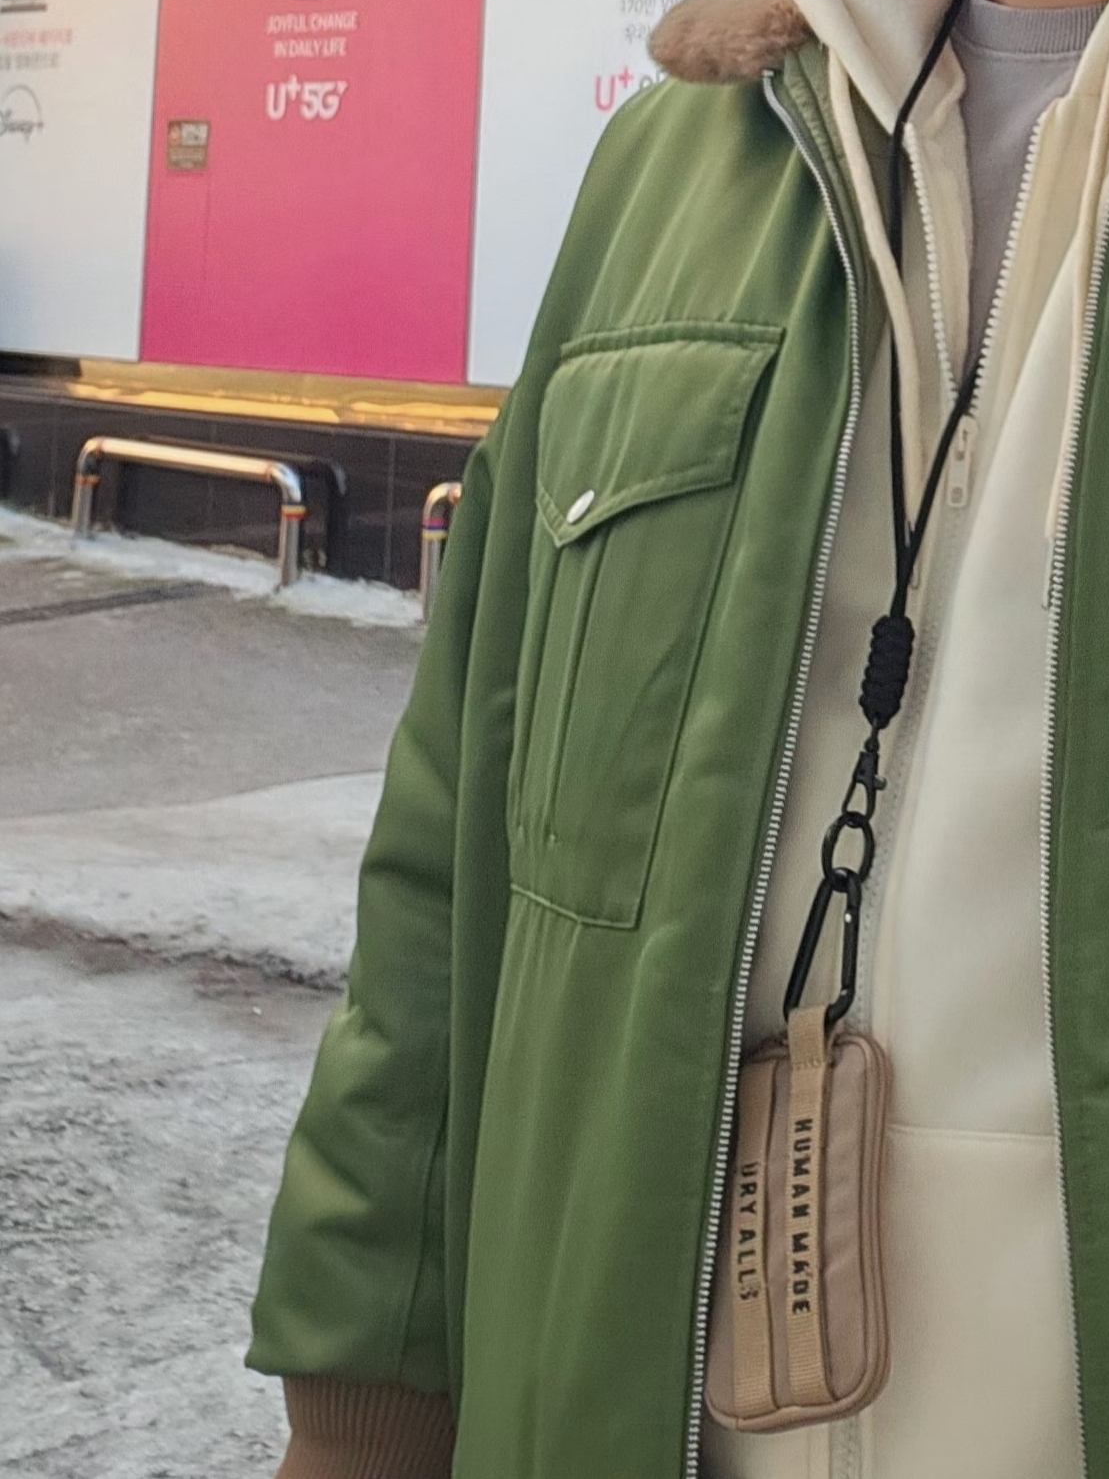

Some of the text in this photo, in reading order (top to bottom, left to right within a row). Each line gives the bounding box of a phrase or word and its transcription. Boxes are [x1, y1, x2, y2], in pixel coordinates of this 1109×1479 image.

[266, 10, 358, 35] JOYFUL CHANGE
[289, 38, 320, 58] DAILY
[322, 36, 347, 57] LIFE
[792, 1118, 813, 1315] HUMAN MADE
